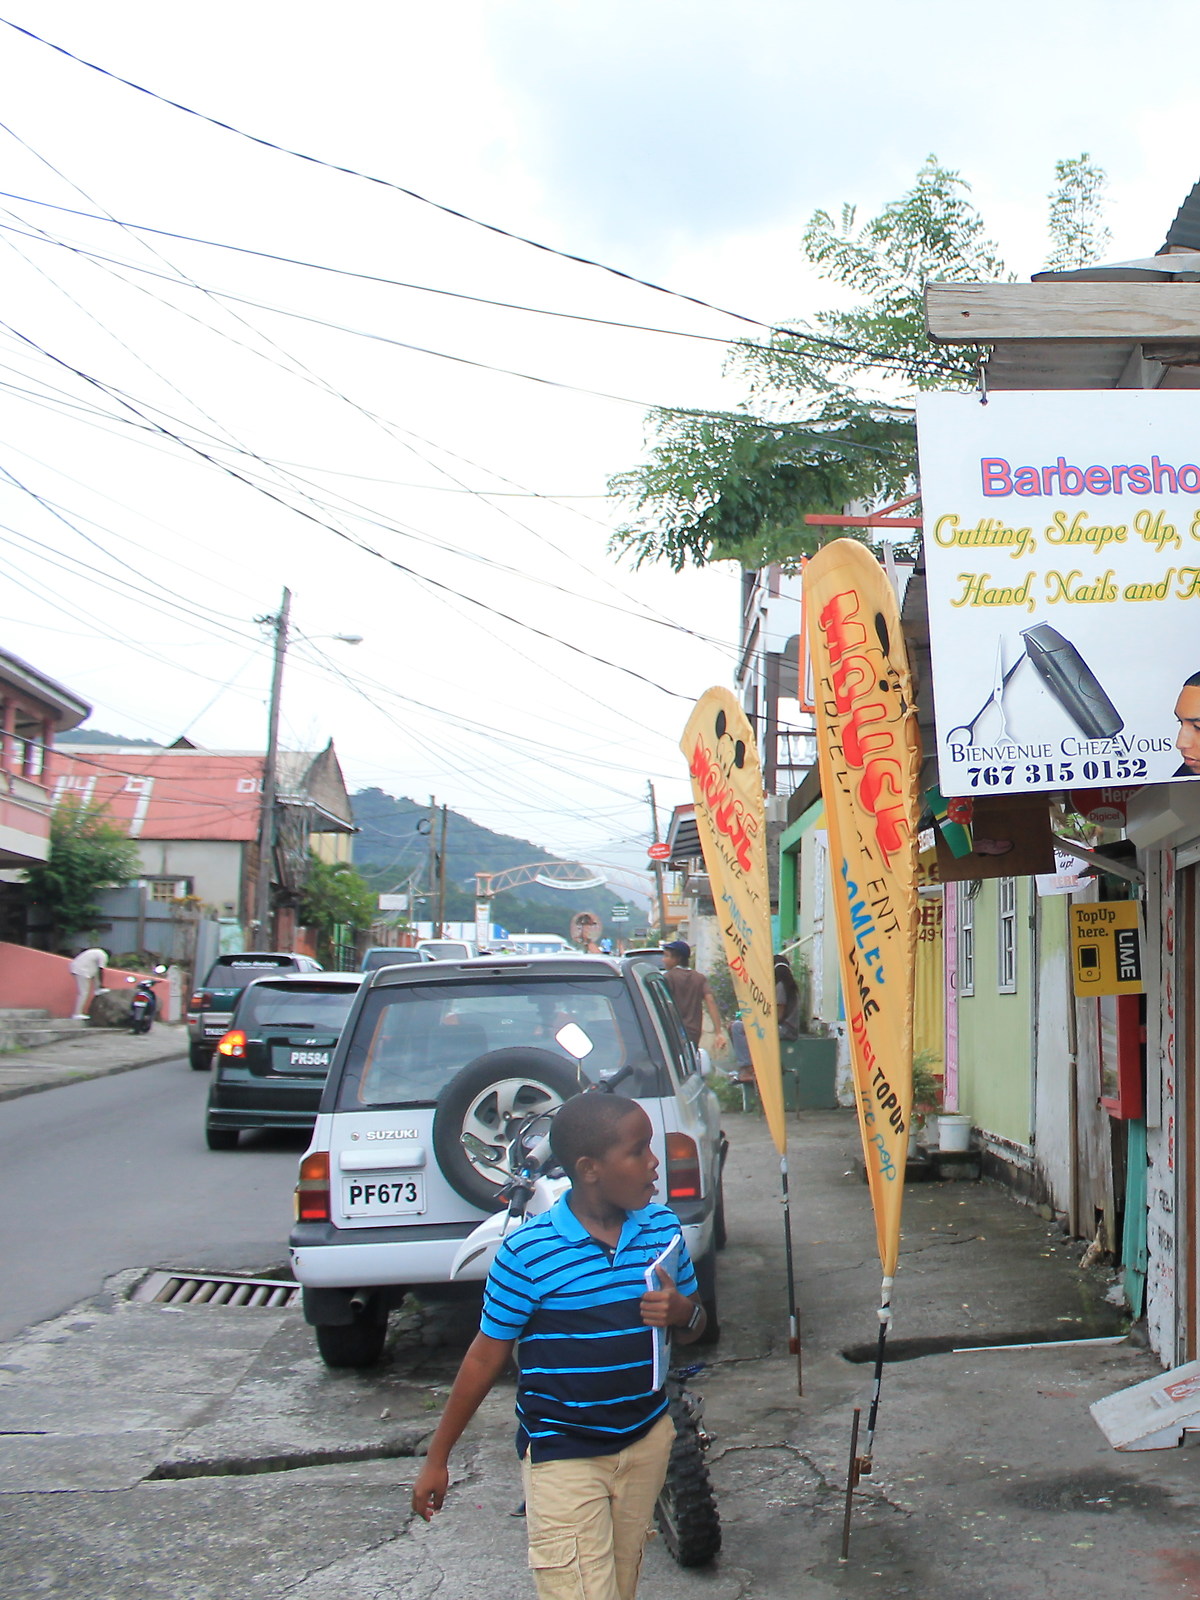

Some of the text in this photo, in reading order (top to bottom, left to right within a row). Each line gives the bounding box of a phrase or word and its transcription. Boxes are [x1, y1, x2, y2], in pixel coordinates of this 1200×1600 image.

[933, 514, 1038, 559] Cutting,
[1045, 508, 1129, 554] Shape
[1133, 508, 1181, 552] Up,
[950, 570, 1038, 612] Hand,
[1045, 569, 1119, 603] Nails
[1123, 568, 1176, 600] and
[951, 742, 1053, 763] BIENVENUE
[967, 758, 1148, 788] 767 315 0152
[1090, 813, 1121, 823] Digicel
[1076, 907, 1116, 926] TopUp
[1078, 925, 1109, 939] here.
[1117, 931, 1137, 979] LIME
[290, 1052, 329, 1065] PR584
[851, 1010, 906, 1136] DIGI TOPUP
[366, 1129, 419, 1141] SUZUKI
[350, 1182, 418, 1206] PF673
